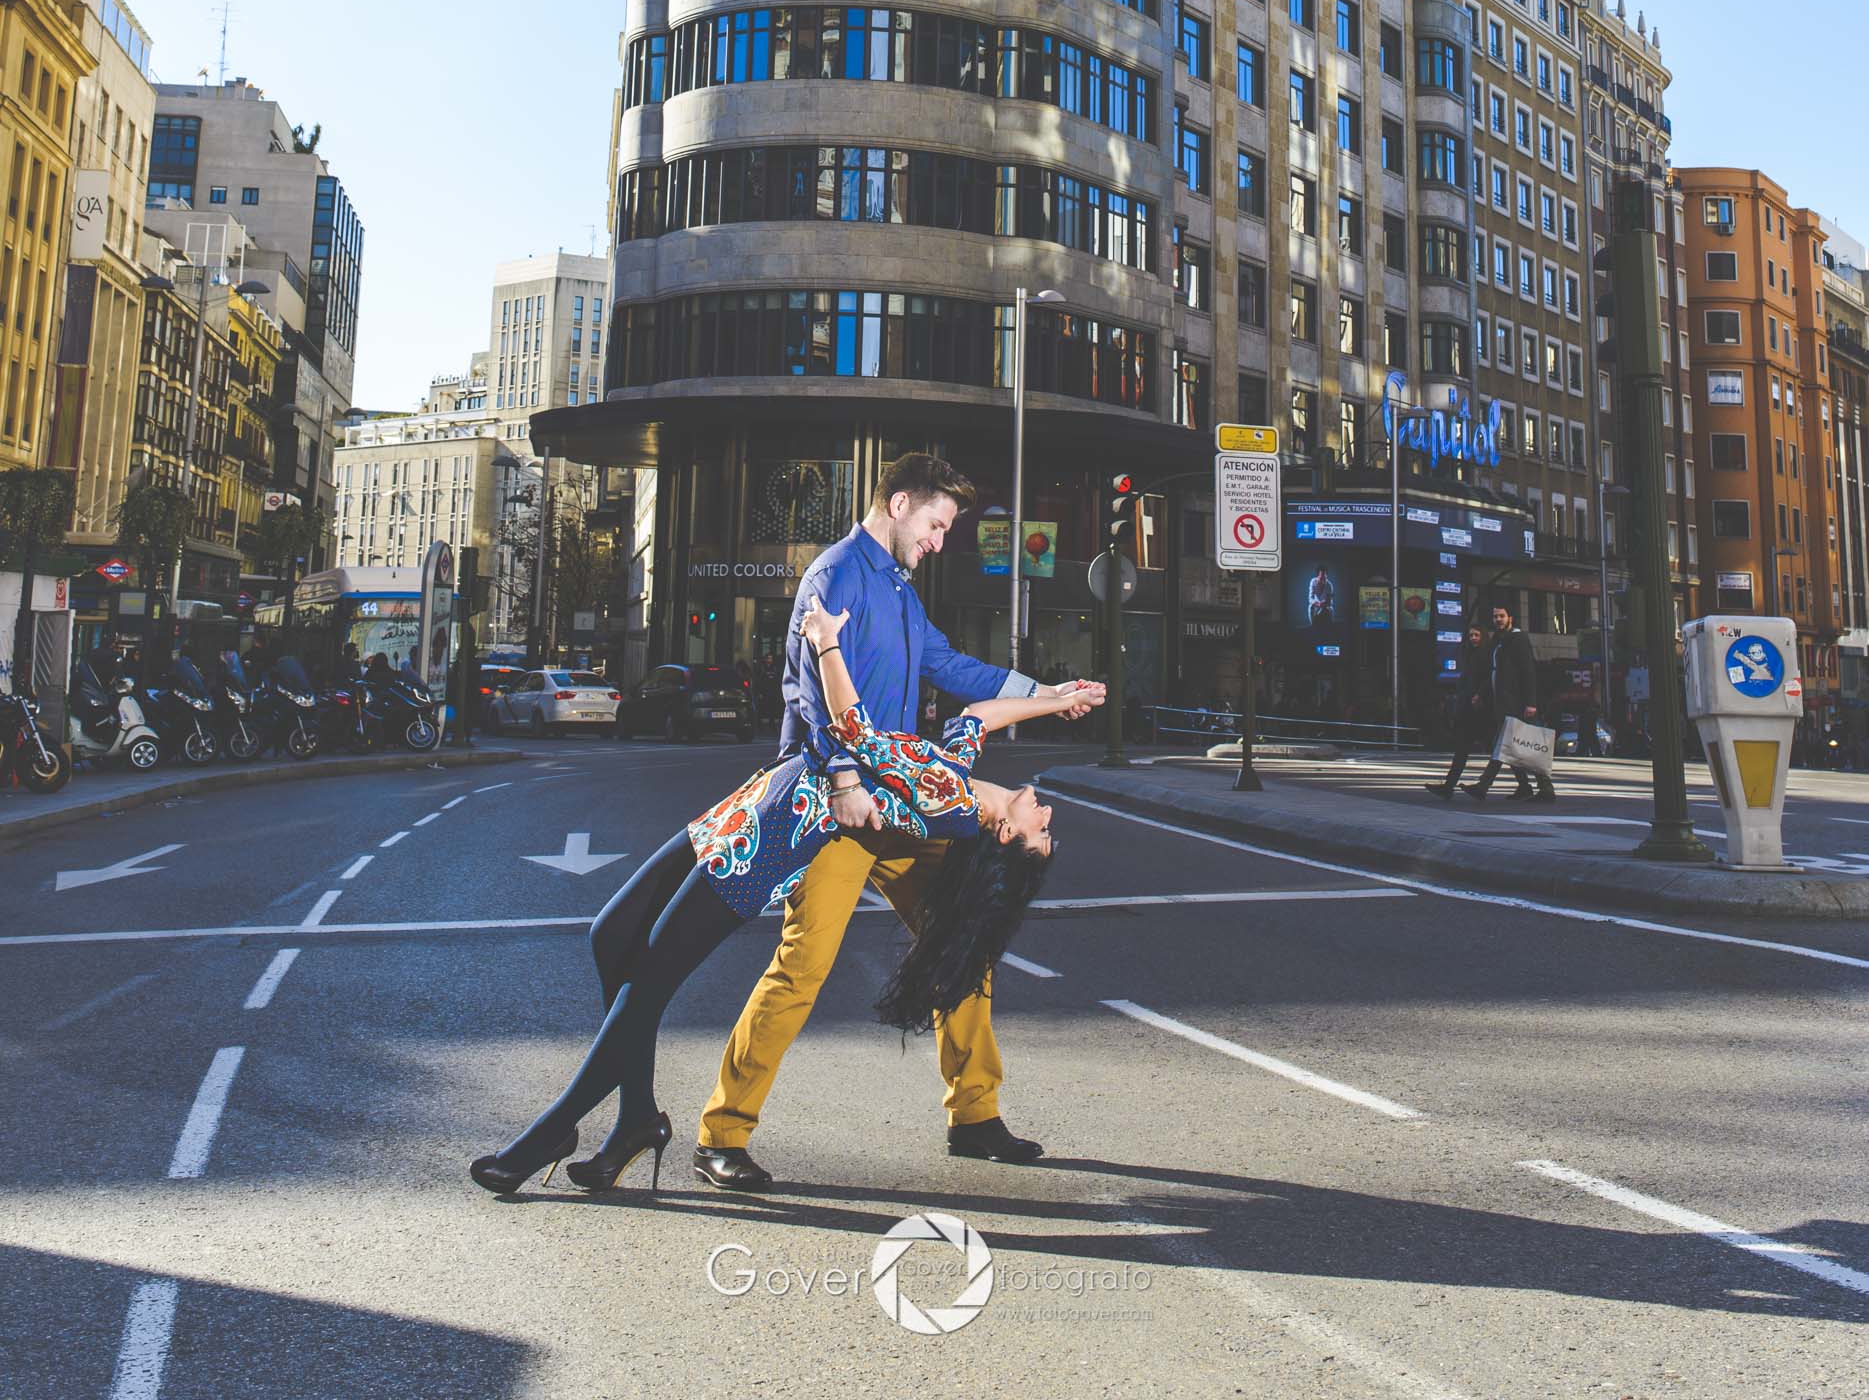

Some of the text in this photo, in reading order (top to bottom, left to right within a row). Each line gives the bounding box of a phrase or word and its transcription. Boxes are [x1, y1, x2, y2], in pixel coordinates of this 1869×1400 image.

[1383, 371, 1501, 468] Capitol
[1223, 460, 1274, 473] ATENCIÓN
[1226, 474, 1262, 482] PERMITIDO
[1224, 490, 1251, 498] SERVICIO
[1230, 498, 1267, 506] RESIDENTES
[688, 563, 729, 577] UNITED
[734, 563, 795, 577] COLORS
[361, 601, 379, 616] 44
[1512, 736, 1549, 753] MANGO
